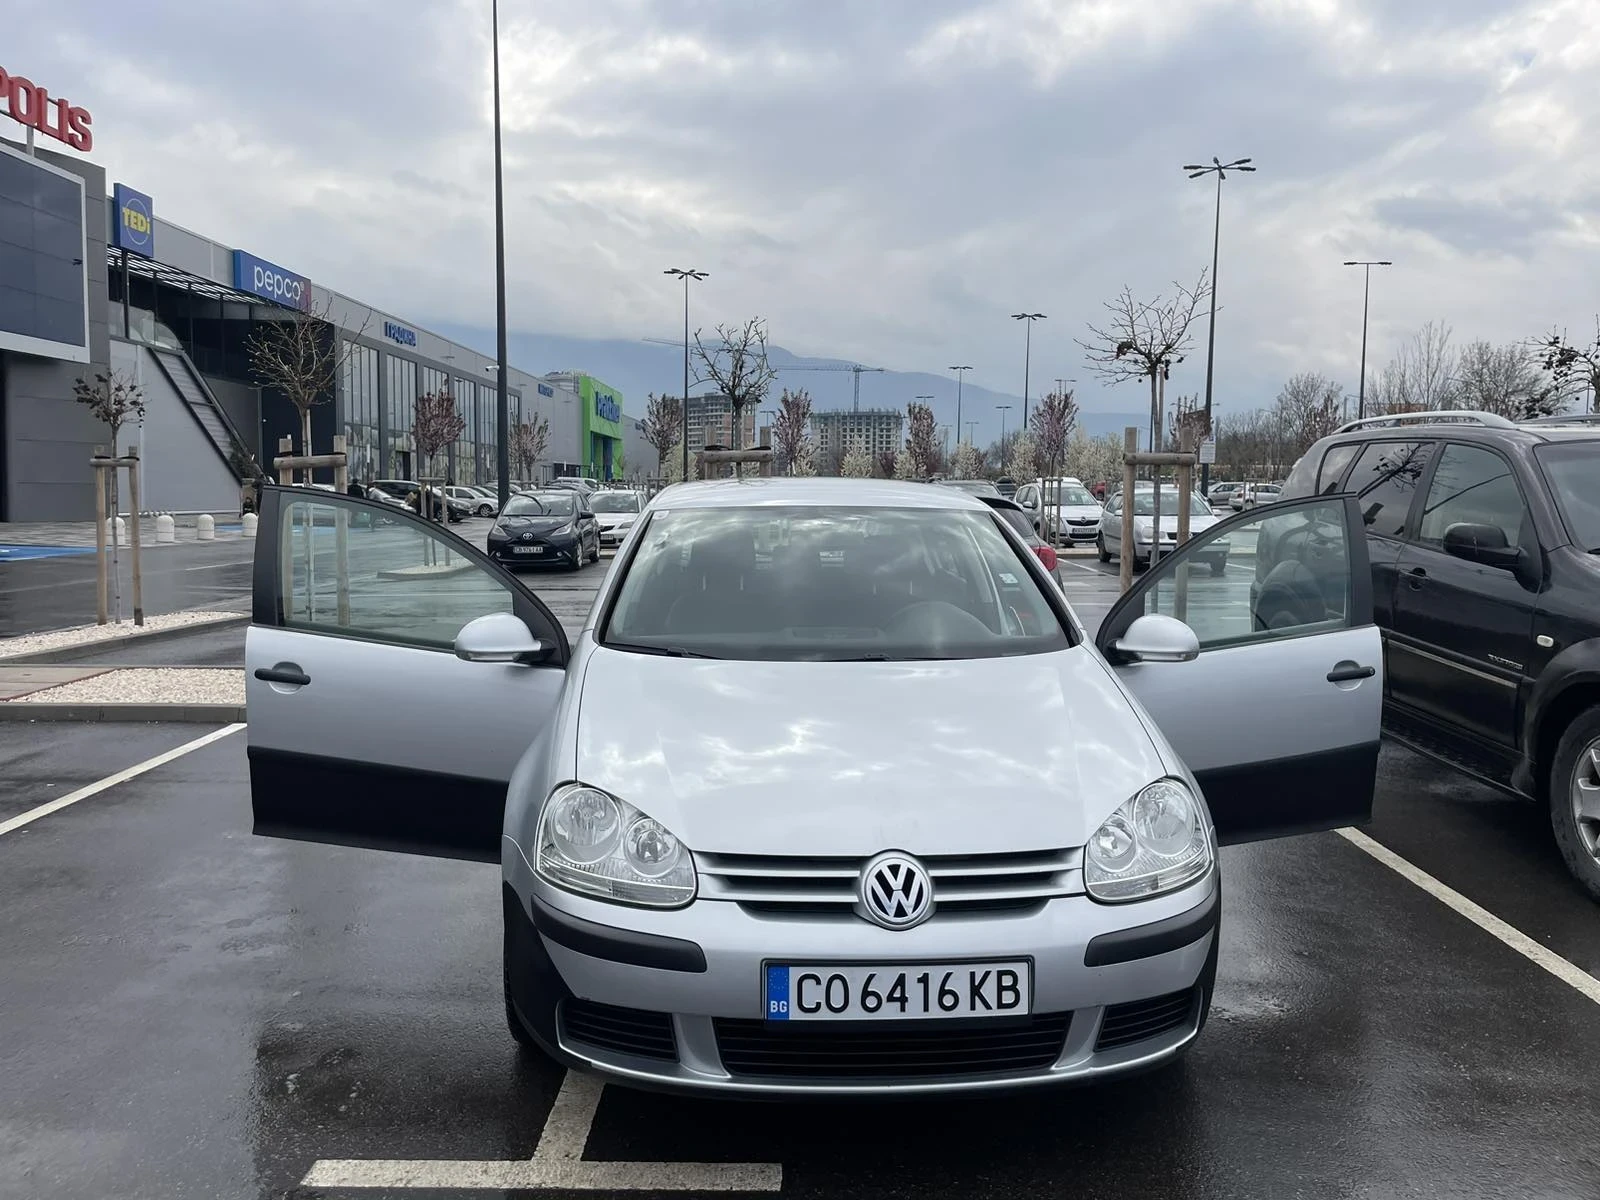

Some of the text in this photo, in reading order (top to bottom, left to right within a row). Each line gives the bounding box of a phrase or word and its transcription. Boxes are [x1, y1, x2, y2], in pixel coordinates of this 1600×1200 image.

[122, 207, 150, 235] TEDi
[254, 265, 301, 301] pepco
[769, 1000, 788, 1013] BG
[796, 969, 1021, 1014] CO 6416 KB
